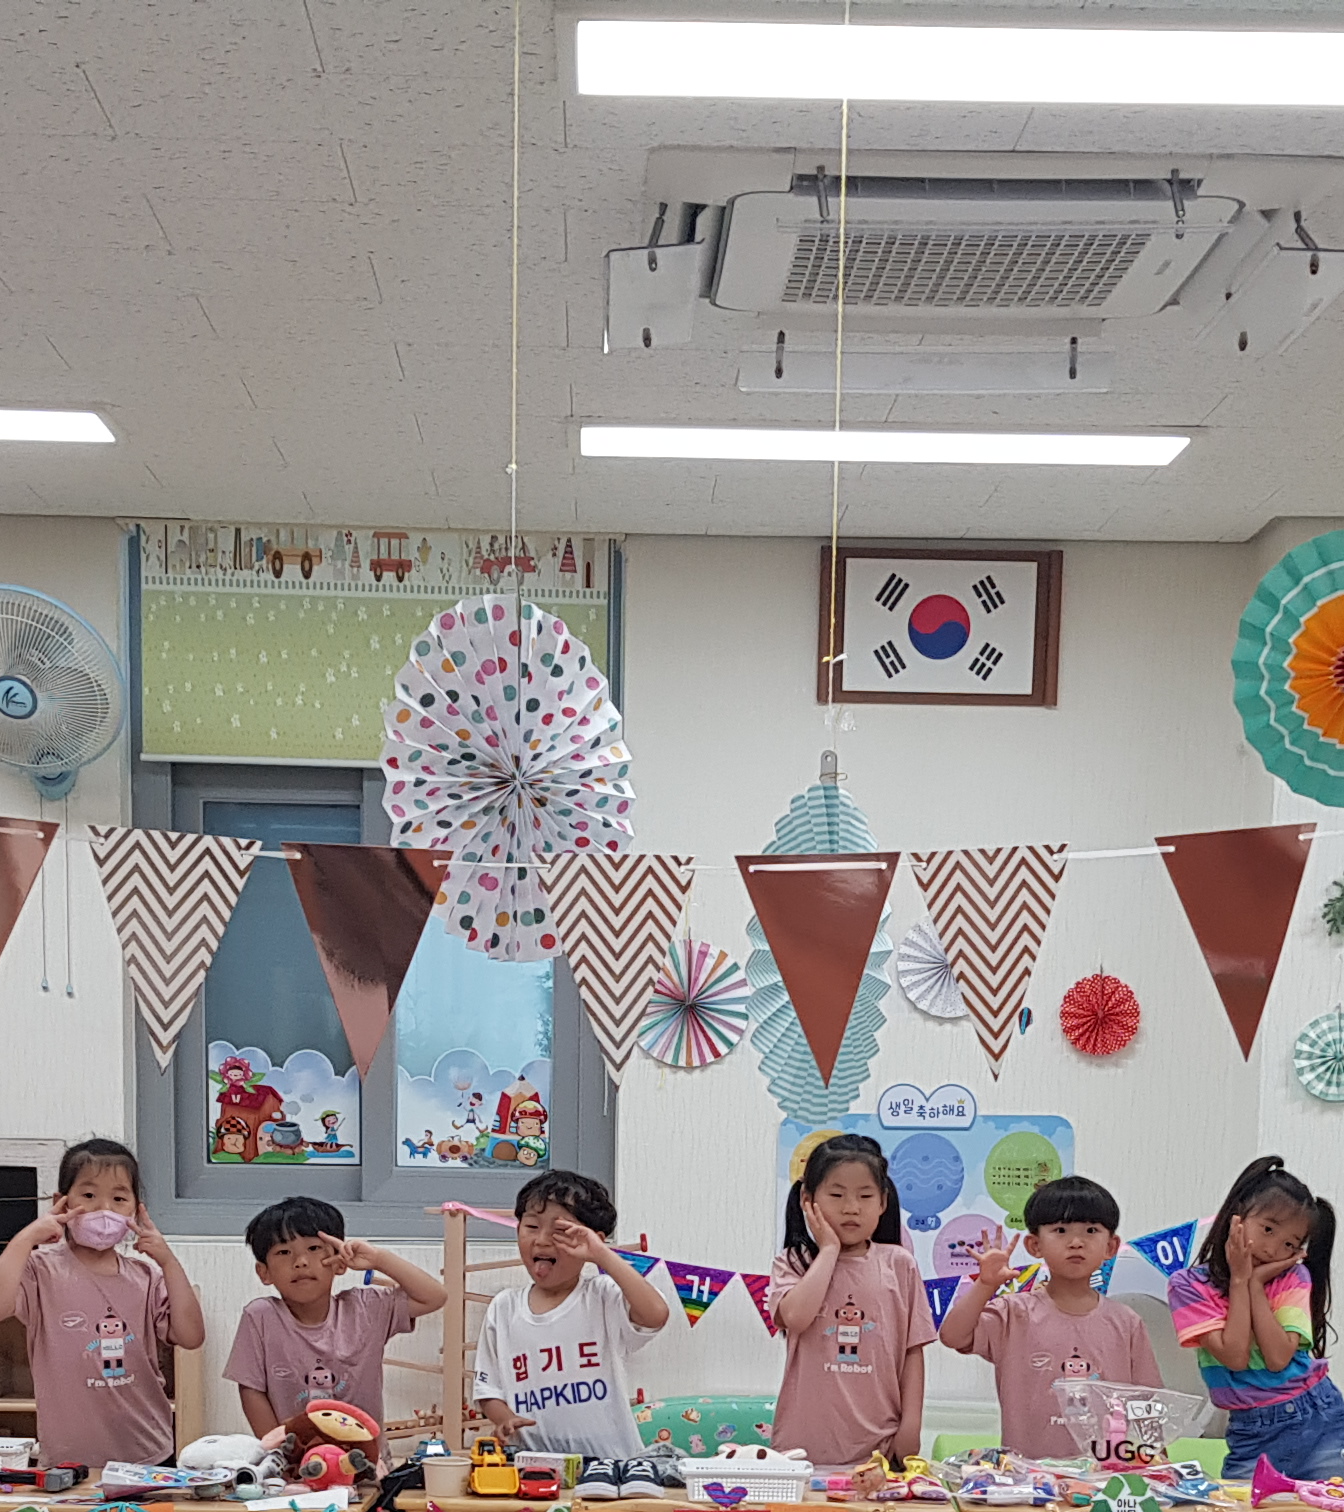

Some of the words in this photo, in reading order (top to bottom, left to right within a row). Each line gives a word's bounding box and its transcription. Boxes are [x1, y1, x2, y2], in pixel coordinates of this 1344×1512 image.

[888, 1098, 914, 1117] 생일
[916, 1103, 967, 1120] 축하해요
[840, 1363, 873, 1374] Robot
[514, 1378, 608, 1414] HAPKIDO
[1090, 1440, 1156, 1465] UGG
[1116, 1498, 1137, 1508] 아나
